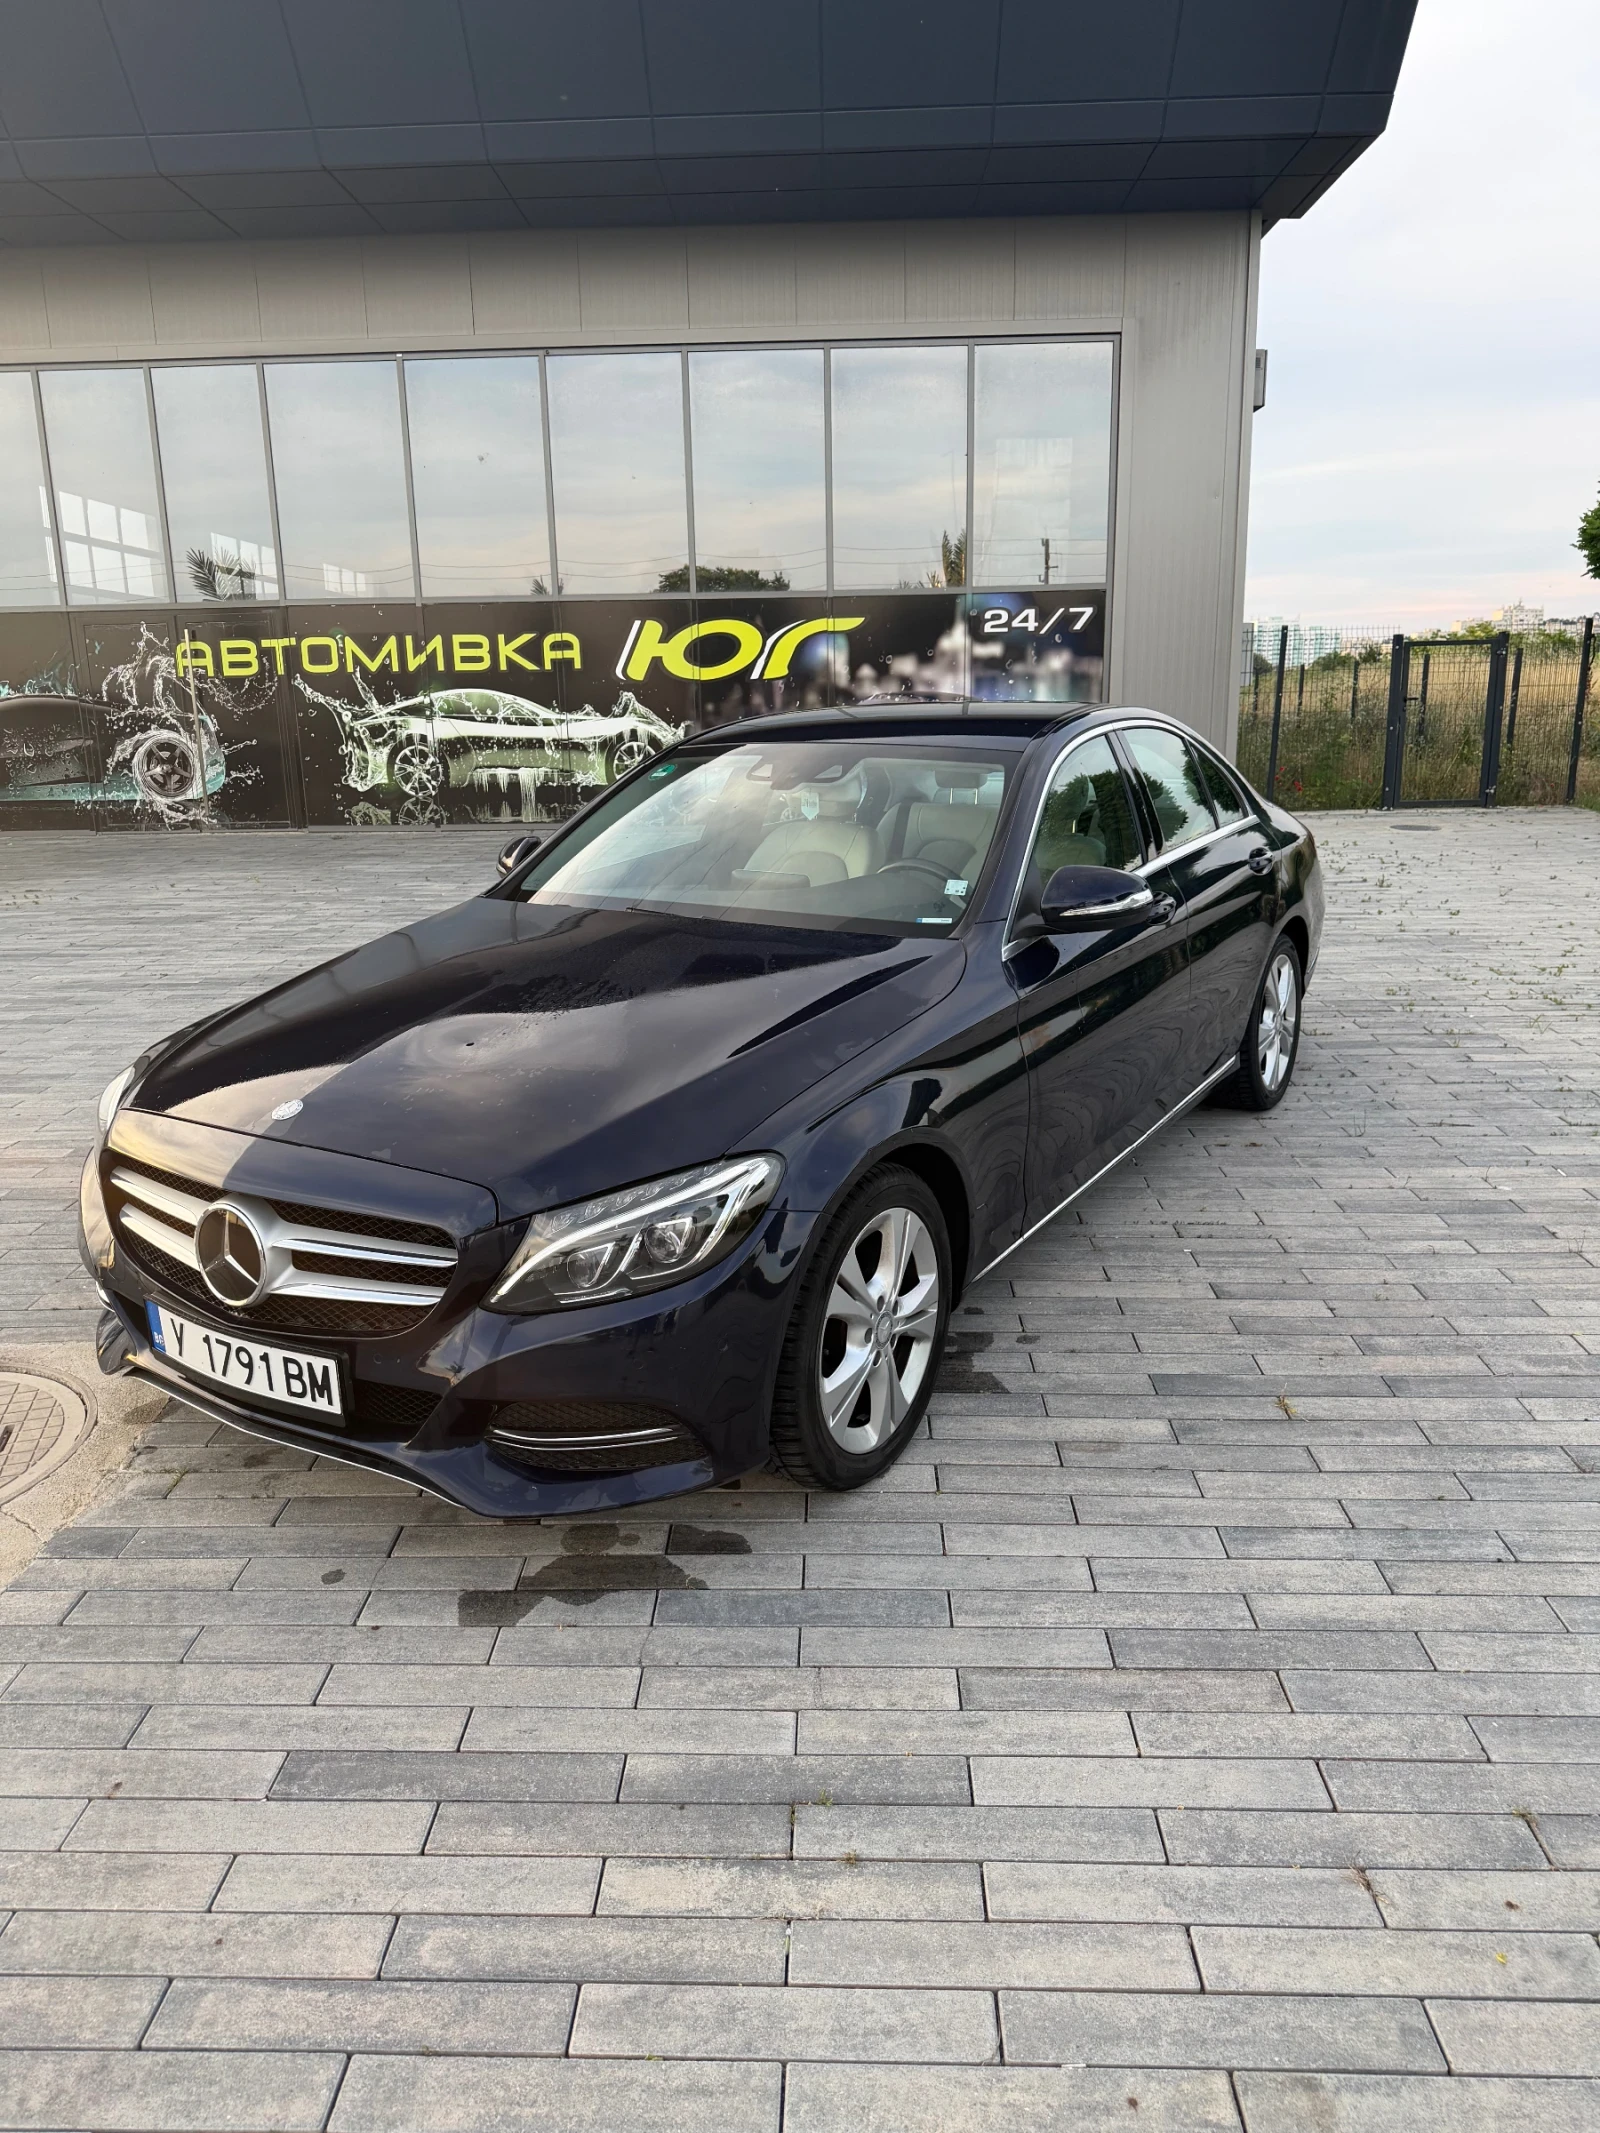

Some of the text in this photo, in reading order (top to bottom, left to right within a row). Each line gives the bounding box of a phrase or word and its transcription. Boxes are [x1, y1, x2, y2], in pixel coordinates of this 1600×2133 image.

[983, 607, 1094, 635] 24/7
[176, 632, 581, 677] АВТОМИВКА
[202, 1334, 275, 1392] 1791
